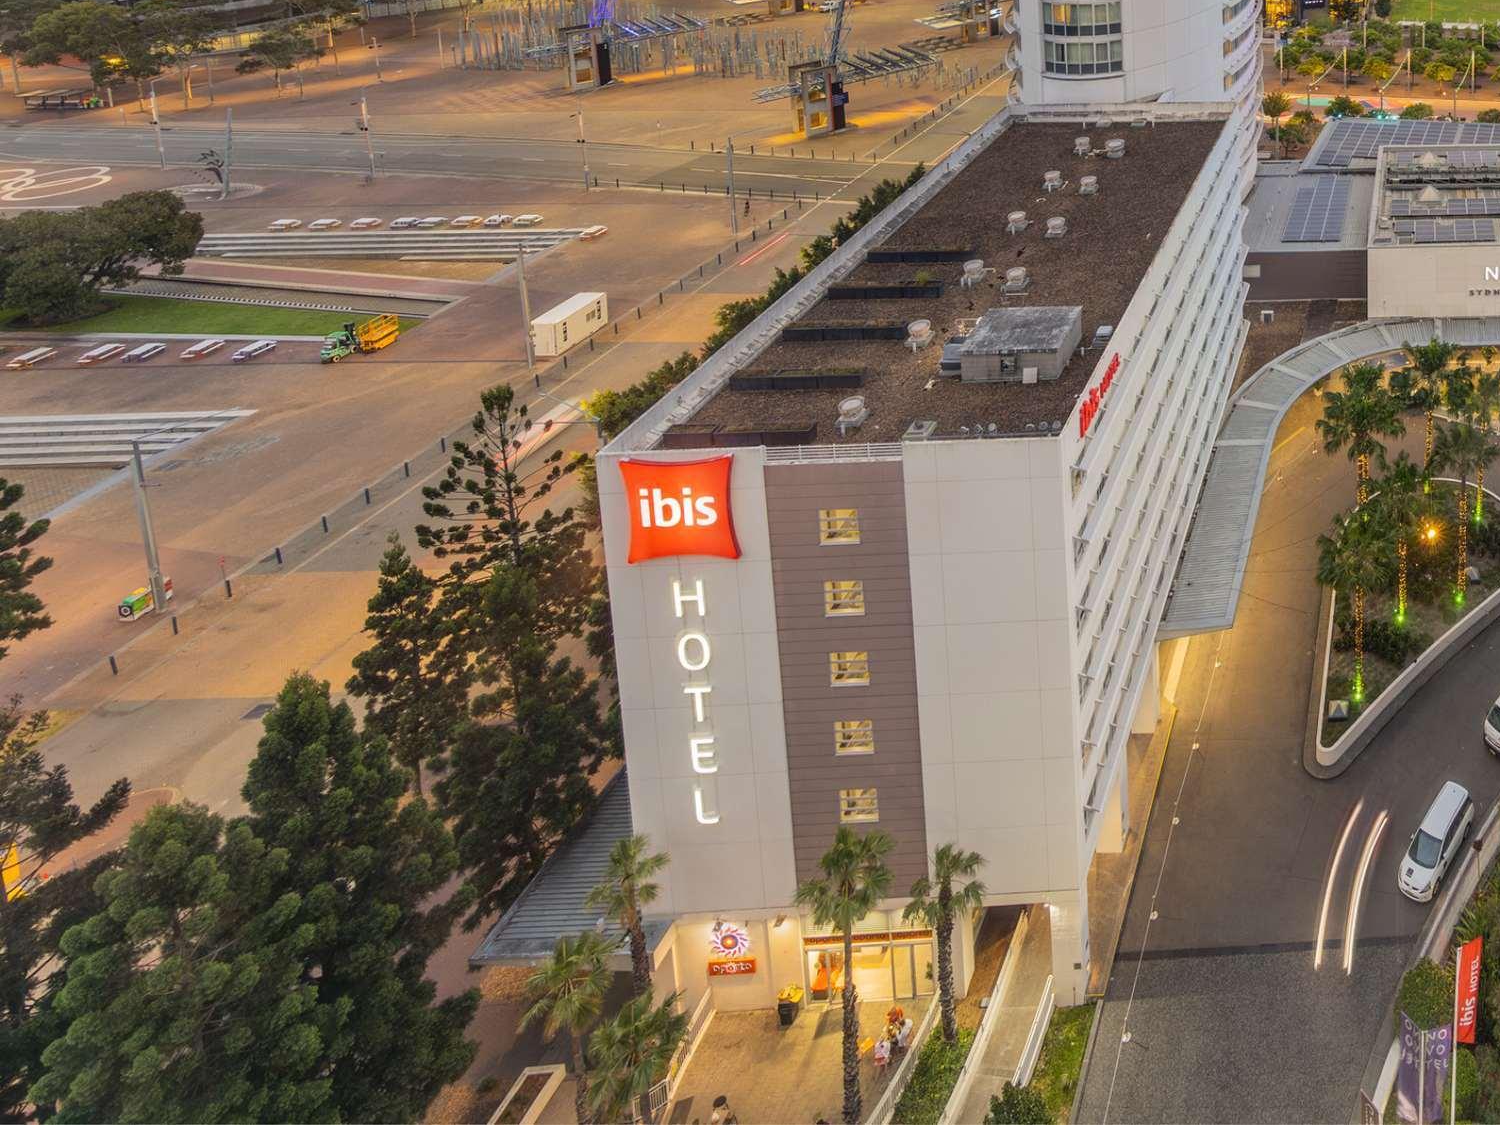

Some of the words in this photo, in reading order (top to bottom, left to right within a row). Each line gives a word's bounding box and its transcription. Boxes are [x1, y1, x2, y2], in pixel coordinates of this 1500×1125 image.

[639, 486, 718, 528] ibis
[672, 579, 720, 825] HOTEL
[1459, 996, 1476, 1026] ibis
[1469, 955, 1480, 992] HOTEL
